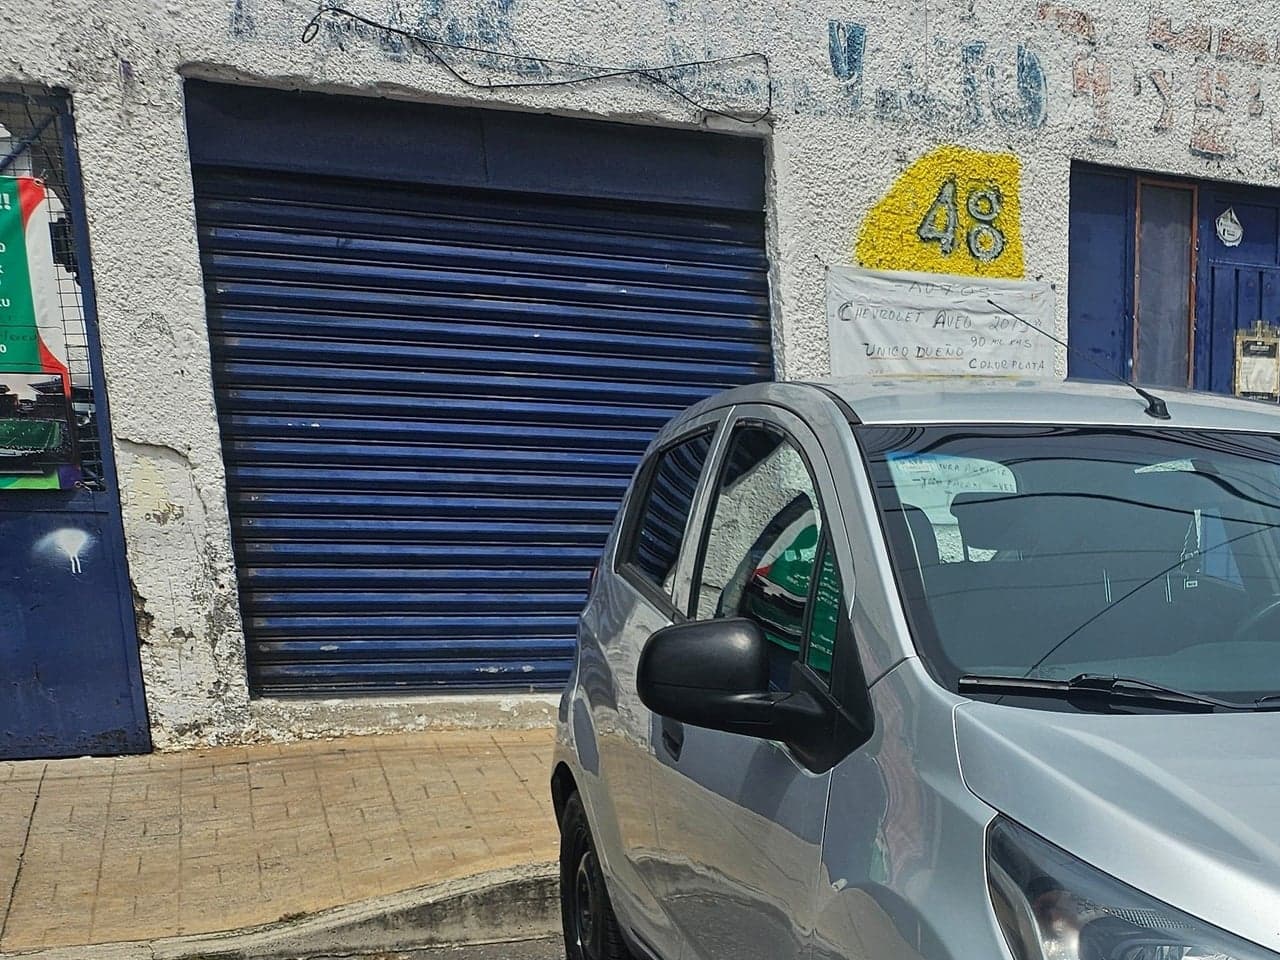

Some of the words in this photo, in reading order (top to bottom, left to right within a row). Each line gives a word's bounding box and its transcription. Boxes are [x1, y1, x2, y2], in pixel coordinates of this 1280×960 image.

[918, 174, 1004, 262] 48
[838, 300, 923, 323] CHEVROLET
[932, 309, 973, 329] AVEO
[916, 344, 964, 358] DUEÑO
[970, 336, 986, 347] 90
